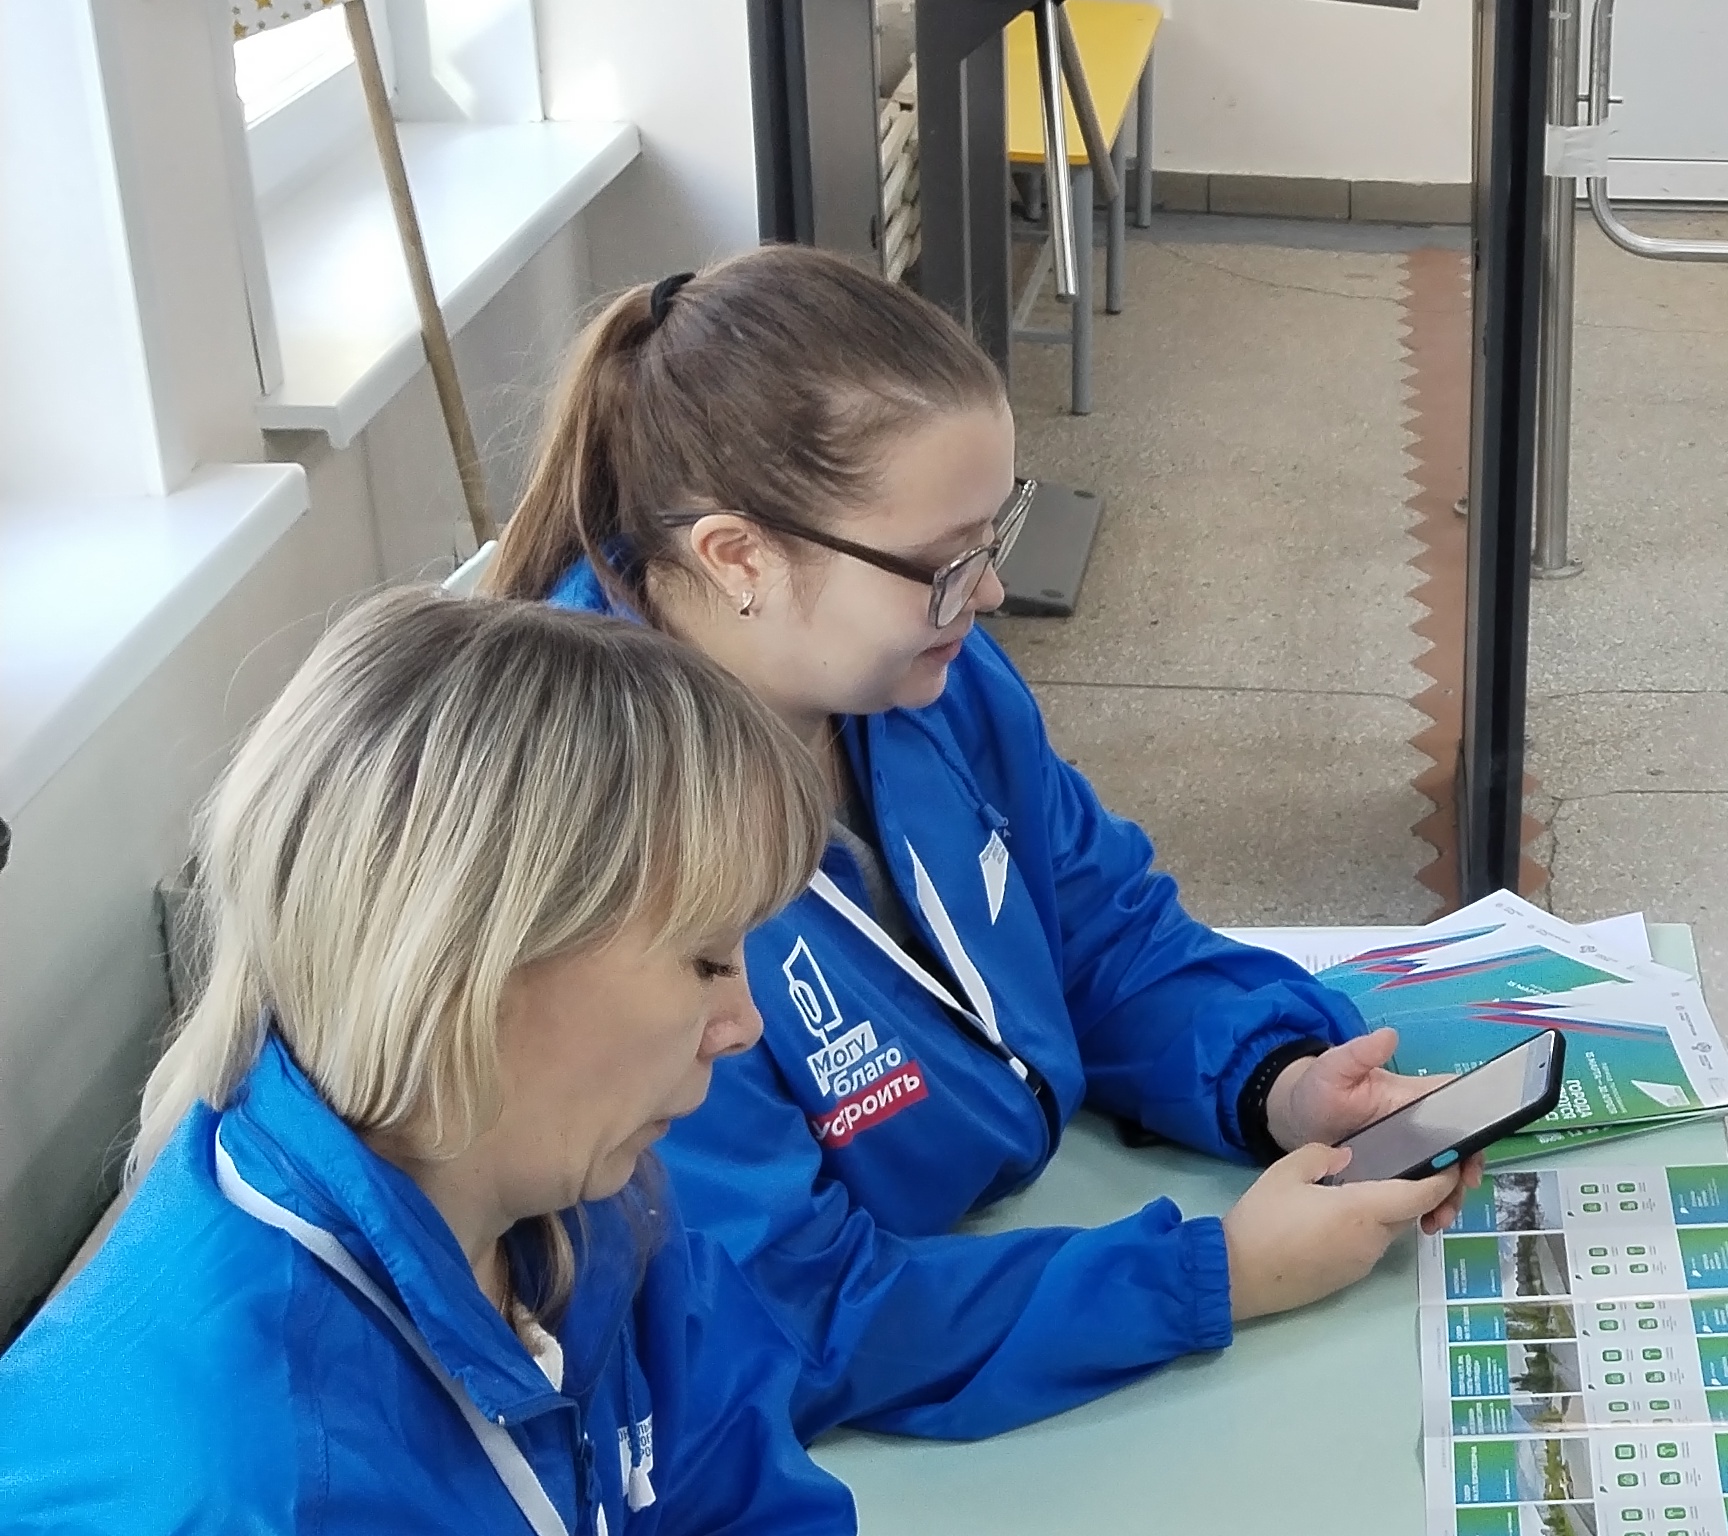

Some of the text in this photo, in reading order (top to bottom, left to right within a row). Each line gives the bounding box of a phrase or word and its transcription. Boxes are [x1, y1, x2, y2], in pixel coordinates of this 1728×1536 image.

[811, 1033, 872, 1081] Могу
[833, 1046, 903, 1097] благо
[811, 1071, 921, 1142] усроить
[1565, 1078, 1593, 1119] ГОРОДА
